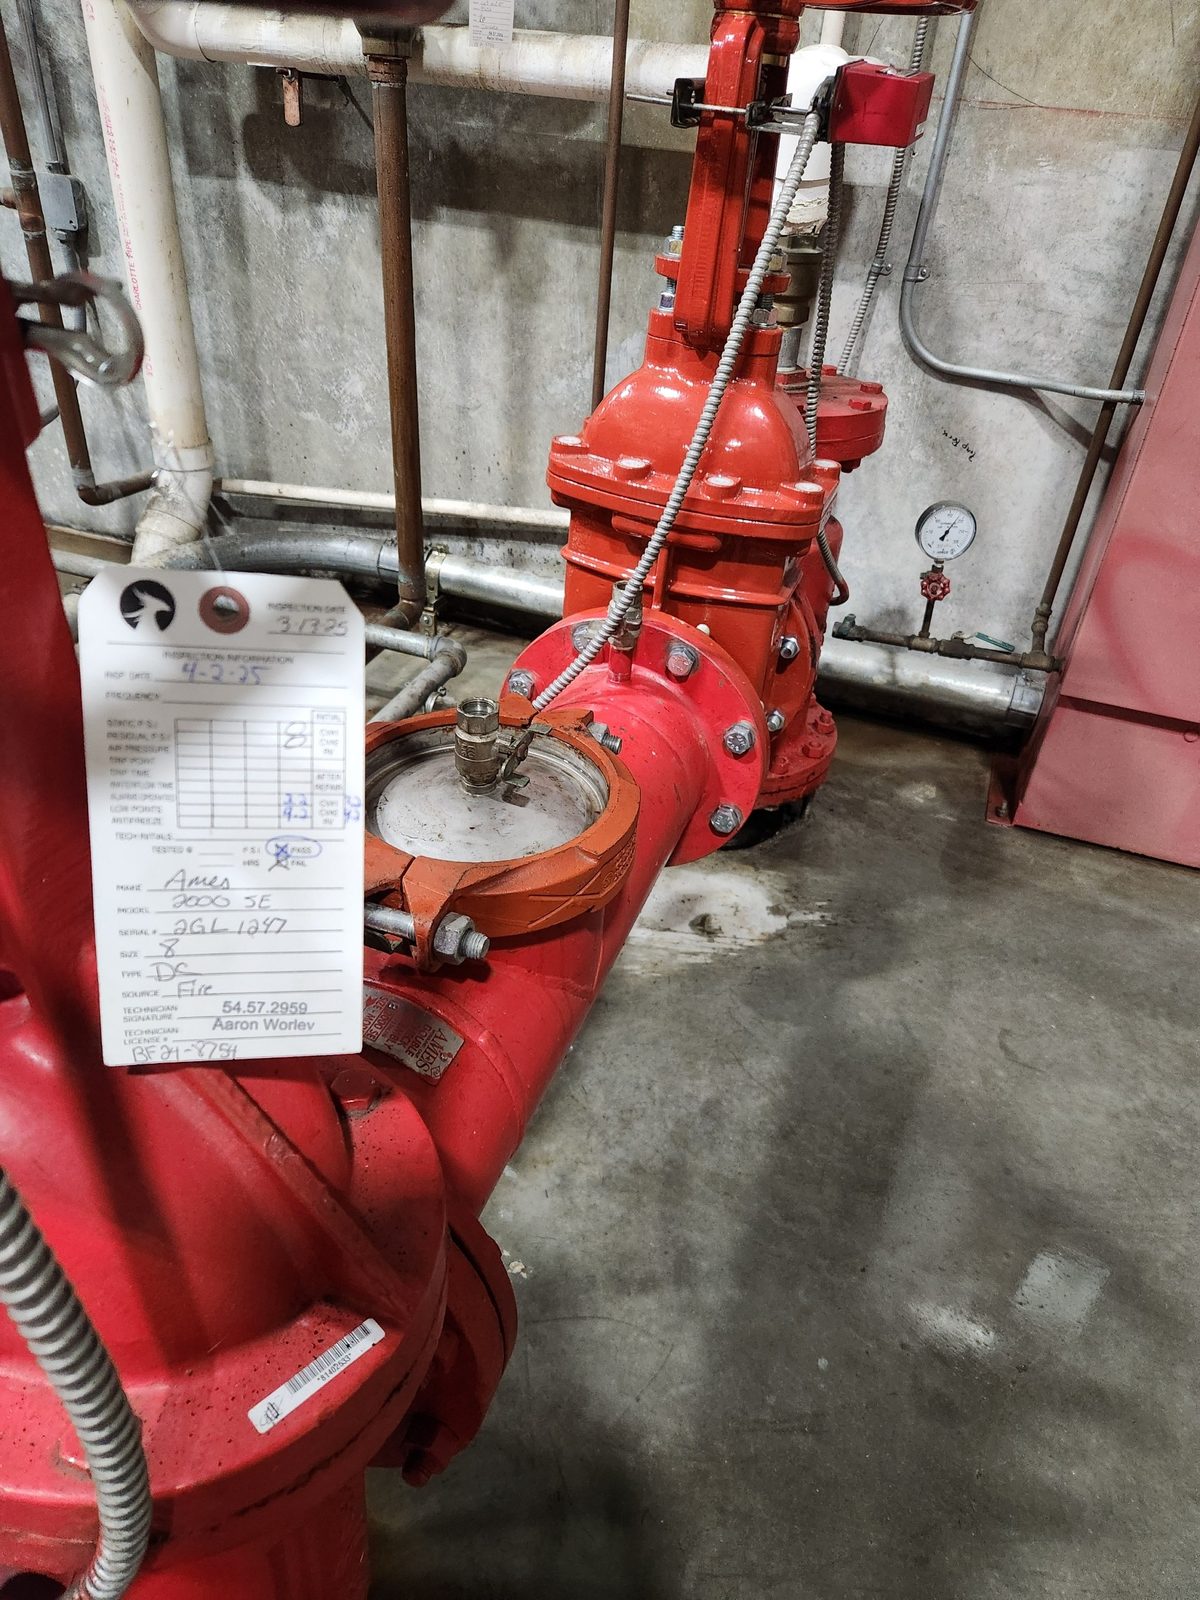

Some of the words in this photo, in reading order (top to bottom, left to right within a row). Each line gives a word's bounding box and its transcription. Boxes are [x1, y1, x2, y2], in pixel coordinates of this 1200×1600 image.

[126, 239, 134, 259] PIPE
[128, 261, 142, 311] CHARLOTTE
[172, 893, 232, 909] 2000
[121, 990, 160, 999] SOURCE
[122, 1005, 178, 1015] TECHNICIAN
[221, 1000, 308, 1015] 54.57.2959
[122, 1014, 173, 1024] SIGNATURE
[211, 1017, 259, 1032] Aaron
[123, 1027, 179, 1038] TECHNICIAN
[123, 1036, 161, 1046] LICENSE
[416, 1028, 448, 1072] AMES
